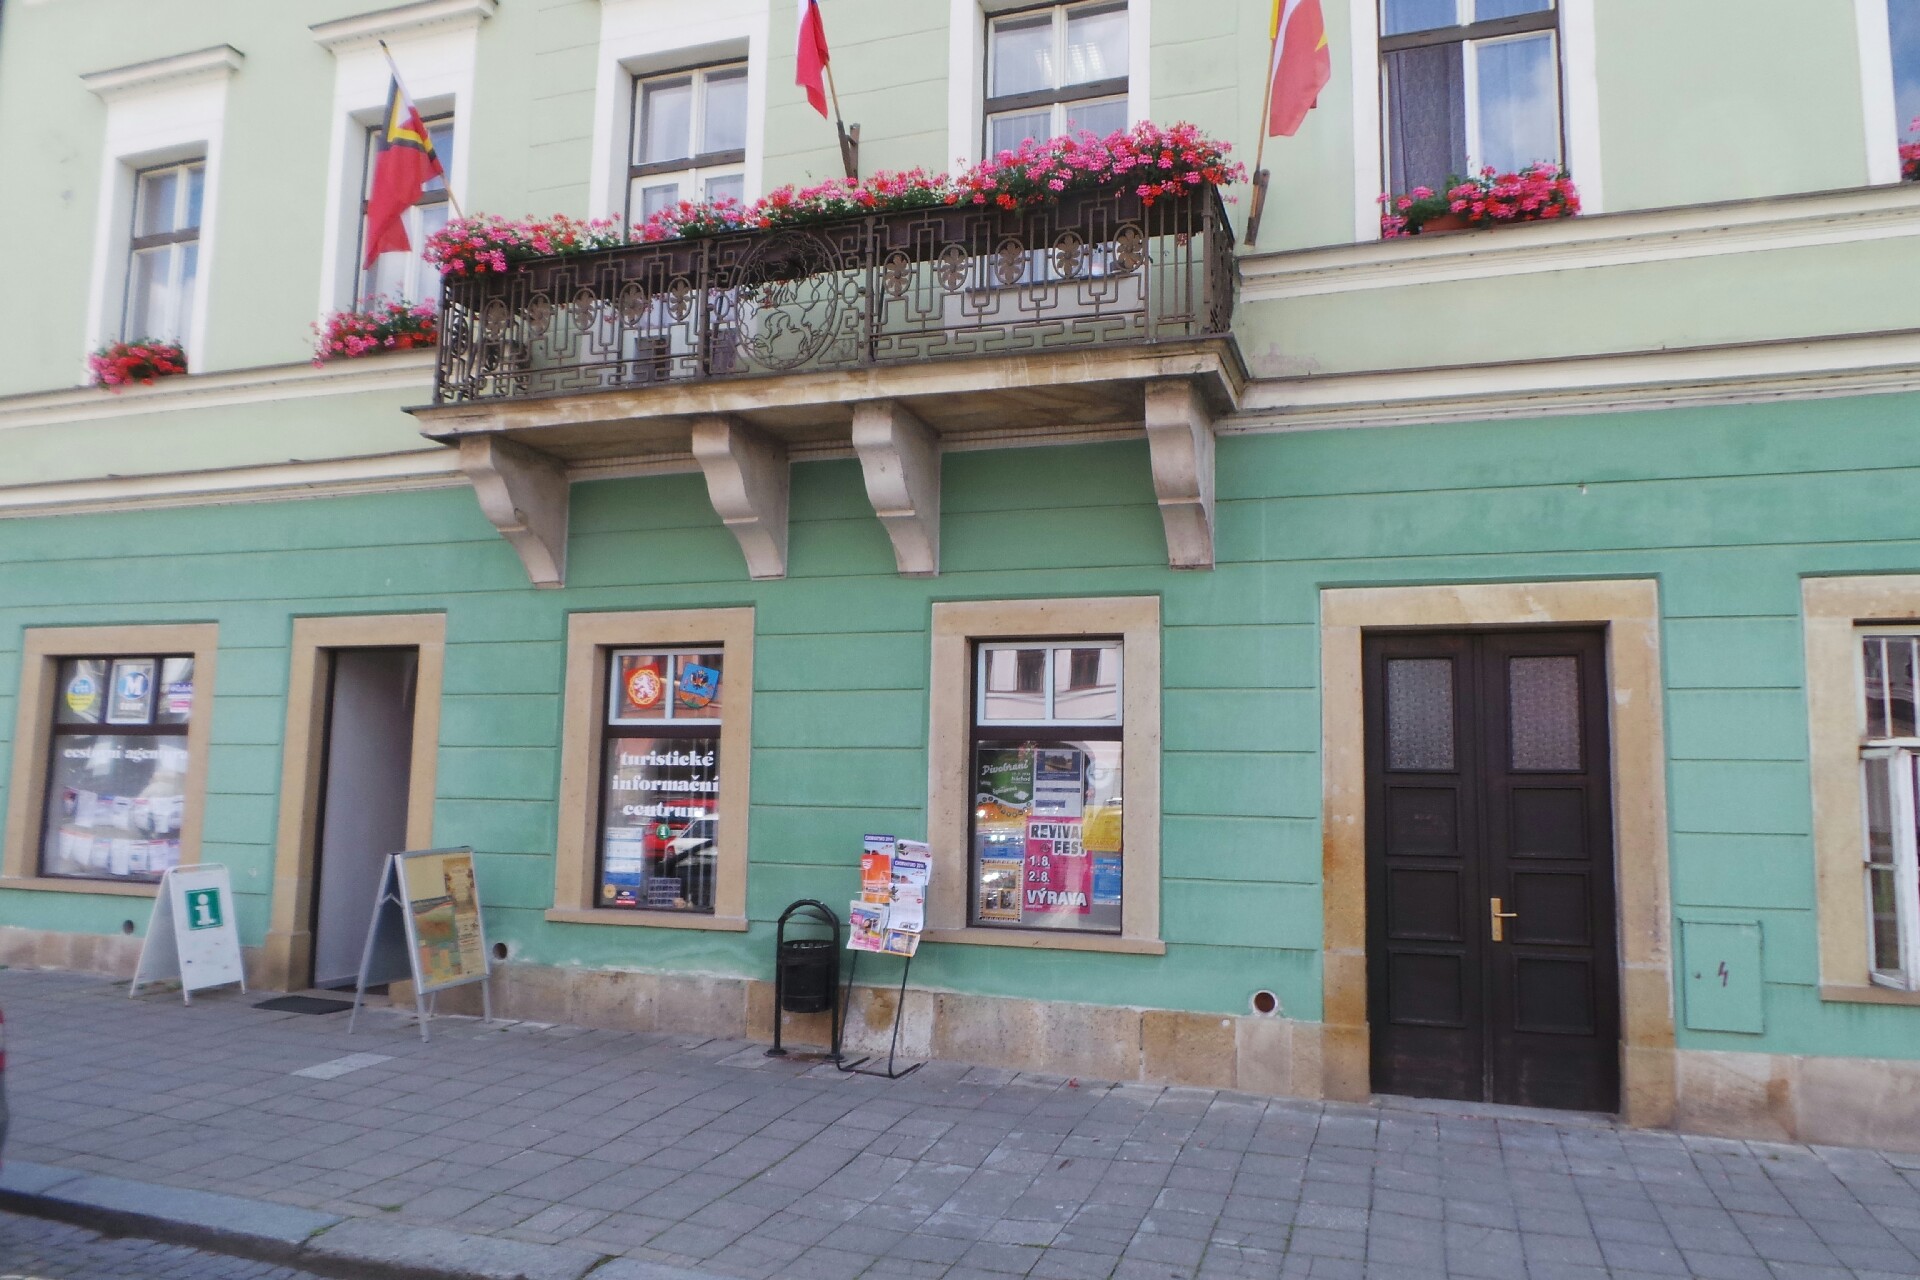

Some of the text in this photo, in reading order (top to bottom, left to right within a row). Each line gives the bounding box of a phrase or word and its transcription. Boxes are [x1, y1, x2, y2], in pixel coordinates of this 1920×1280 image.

[125, 676, 142, 696] M
[620, 750, 714, 767] turistické
[612, 775, 719, 792] informační
[622, 802, 705, 818] centrum
[1029, 855, 1051, 867] 1.8.
[1028, 871, 1050, 883] 2.8.
[1027, 887, 1087, 905] VÝRAVA
